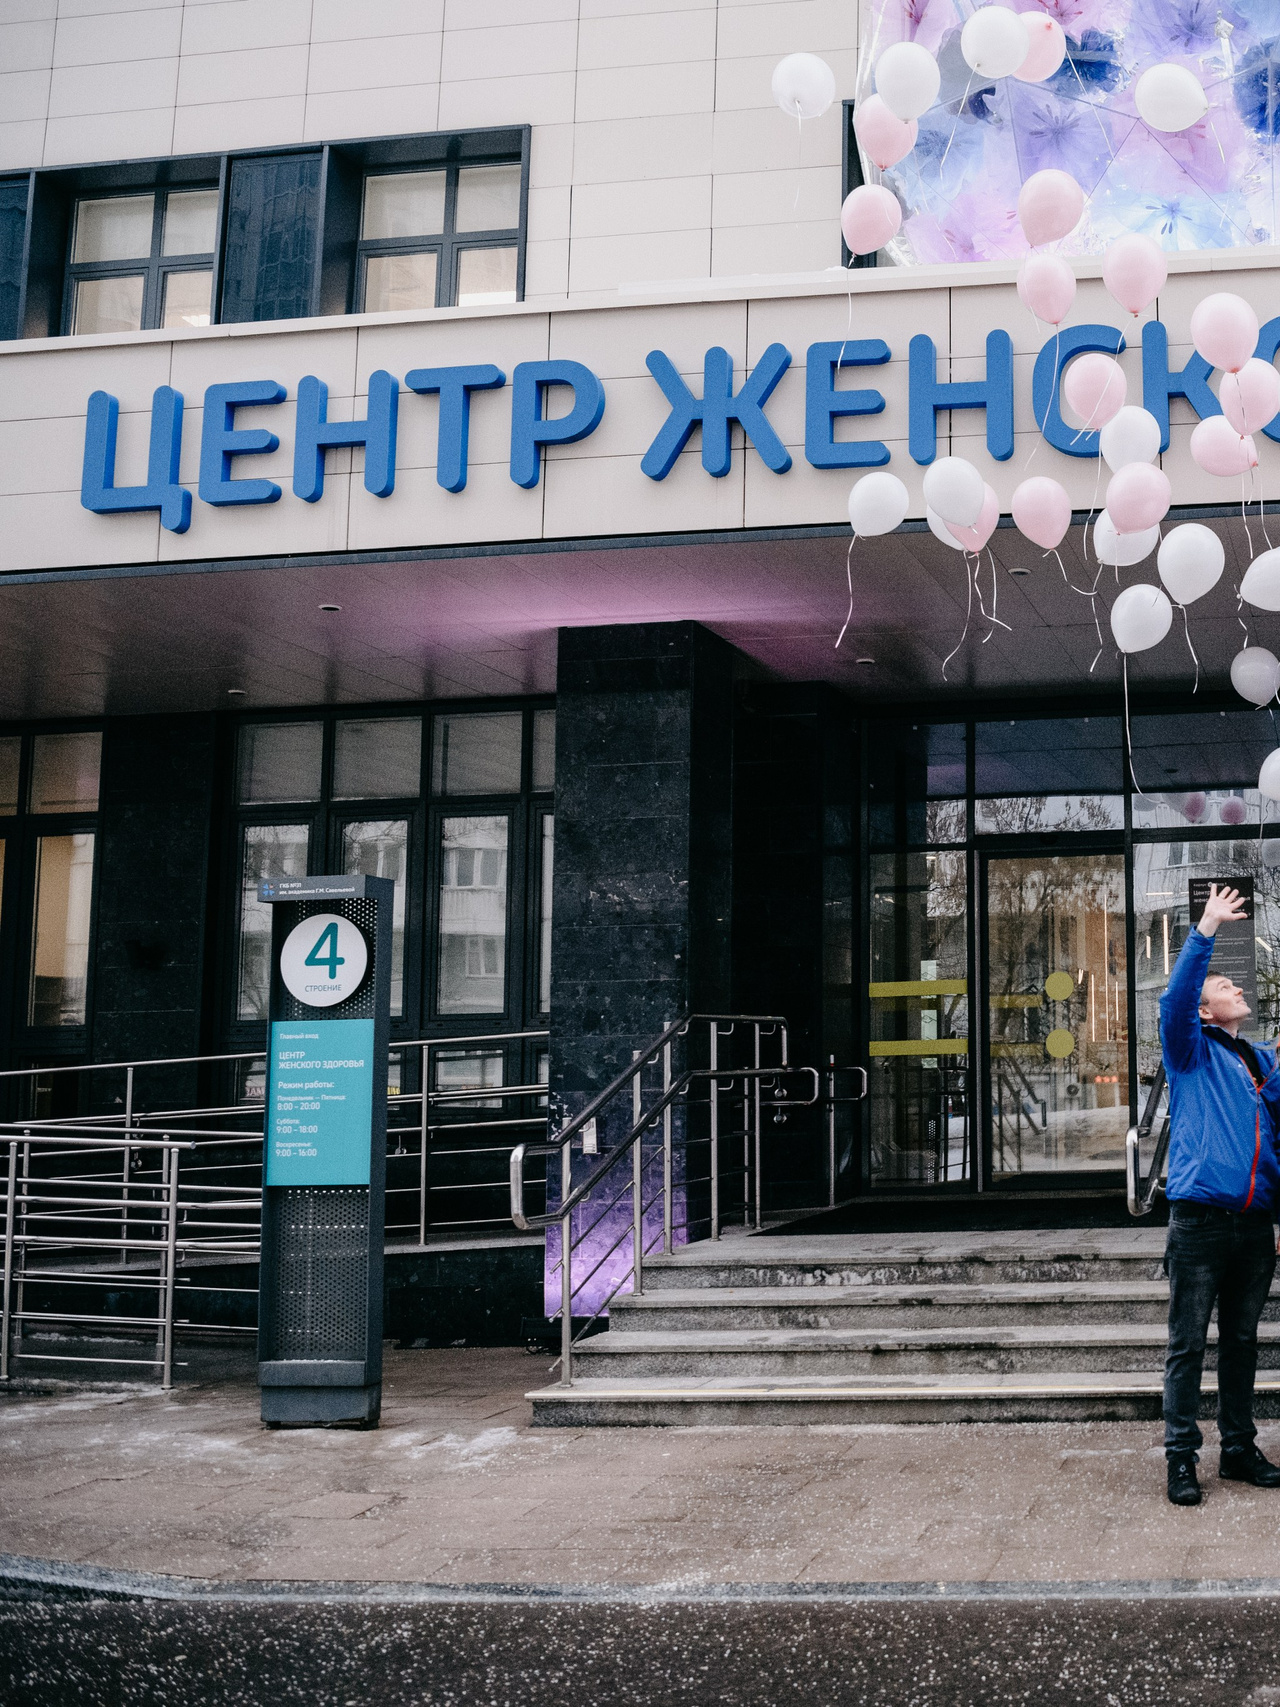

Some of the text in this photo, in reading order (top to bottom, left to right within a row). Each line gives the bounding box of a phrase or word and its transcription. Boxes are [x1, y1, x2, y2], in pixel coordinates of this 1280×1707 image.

[81, 359, 605, 534] ЦЕНТР
[304, 922, 345, 980] 4
[305, 984, 342, 993] СТРОЕНИЕ
[279, 1052, 306, 1060] ЦЕНТР
[278, 1060, 364, 1069] ЖЕНСКОГО ЗДОРОВЬЯ
[304, 1080, 335, 1090] работы:
[277, 1102, 293, 1111] 8:00
[300, 1102, 321, 1110] 20:00
[276, 1126, 292, 1134] 9:00
[298, 1125, 318, 1133] 18:00
[275, 1149, 292, 1157] 9:00
[298, 1149, 317, 1157] 16:00
